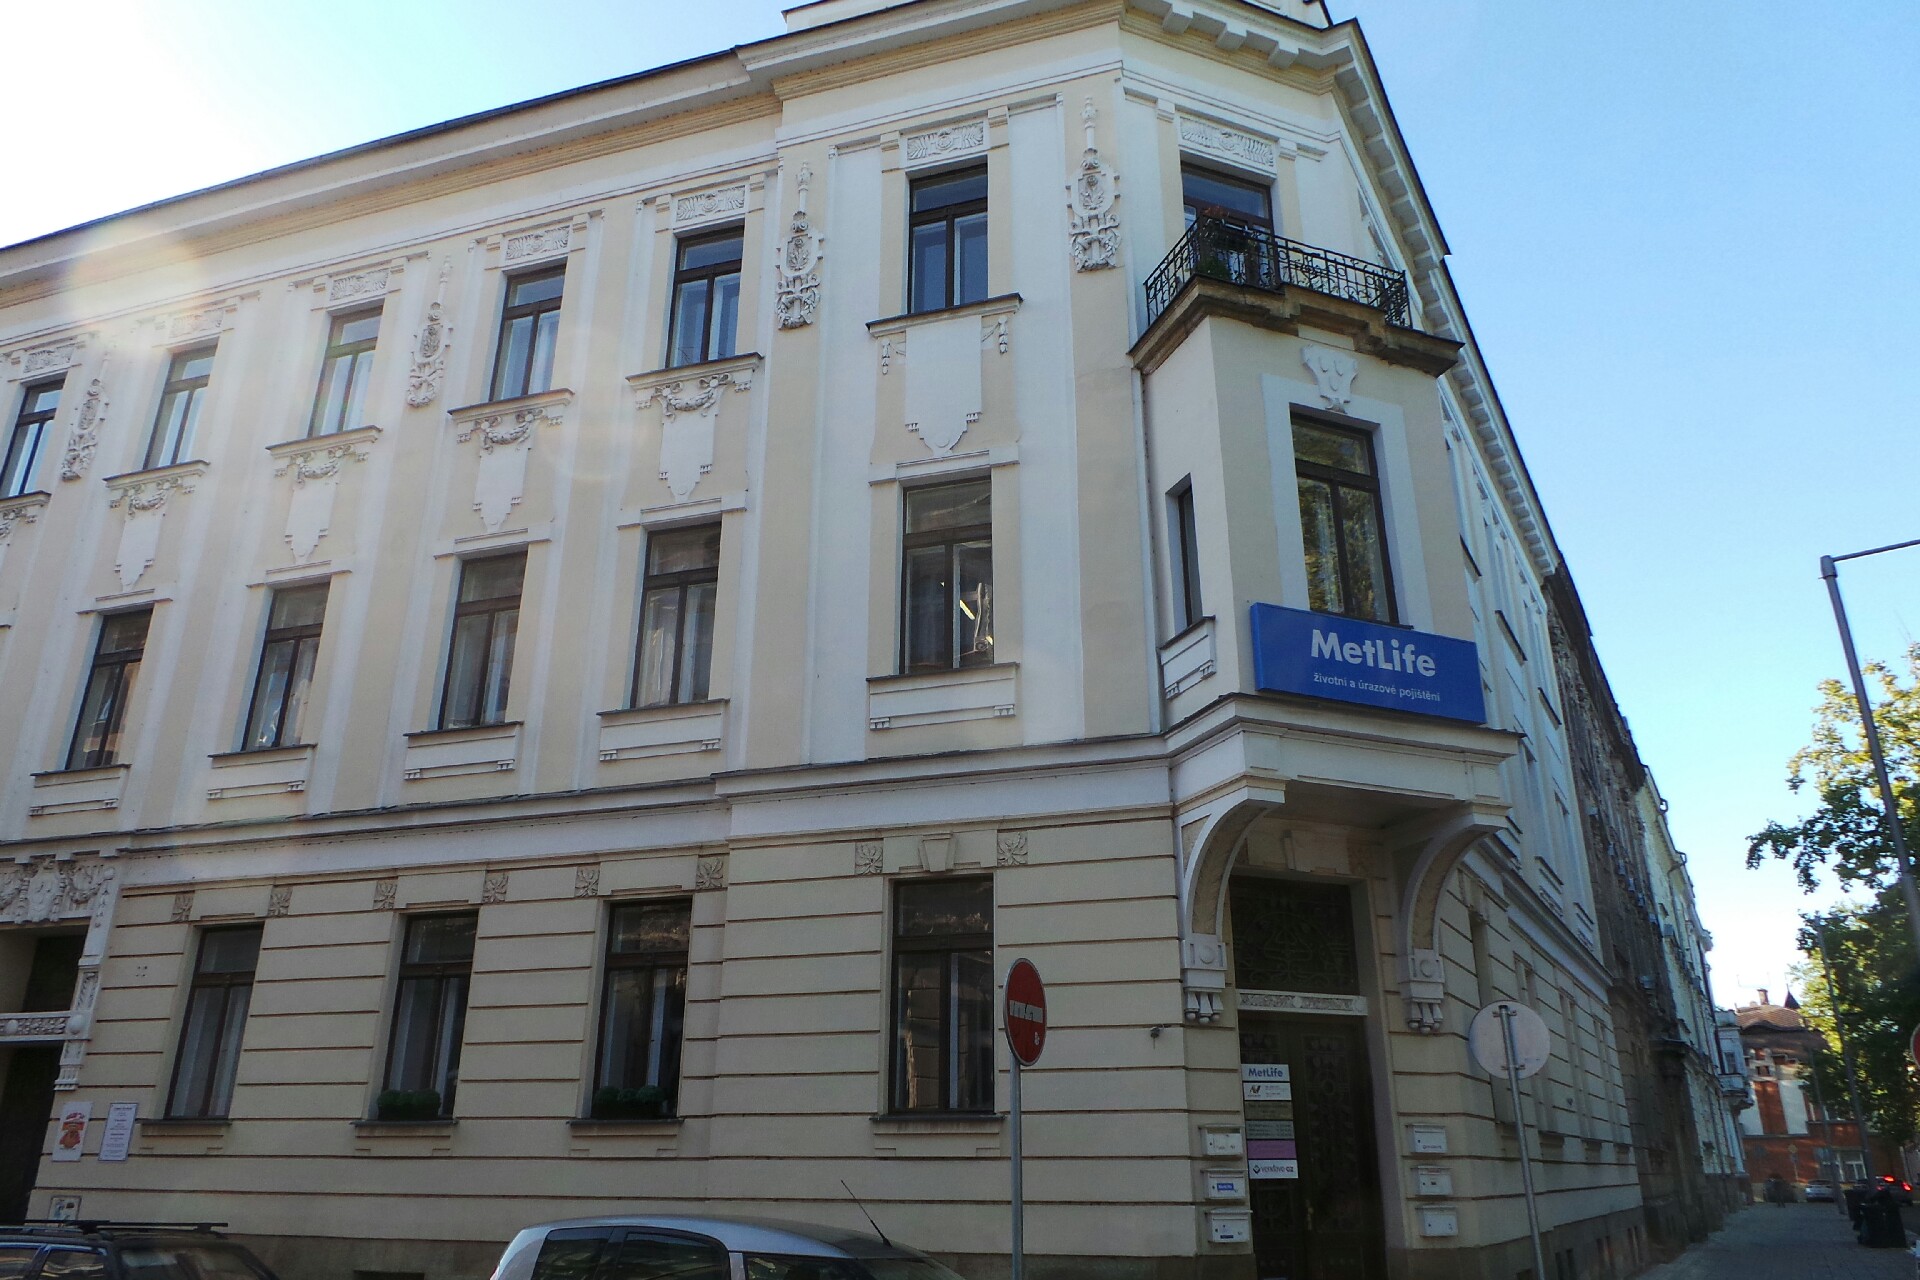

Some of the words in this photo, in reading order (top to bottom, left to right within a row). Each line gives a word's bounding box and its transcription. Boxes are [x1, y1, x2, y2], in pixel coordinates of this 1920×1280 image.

[1311, 629, 1436, 677] MetLife
[1313, 672, 1347, 687] životní
[1349, 680, 1356, 688] a
[1358, 680, 1397, 695] úrazové
[1399, 687, 1441, 702] pojištění
[1248, 1067, 1284, 1078] MetLife
